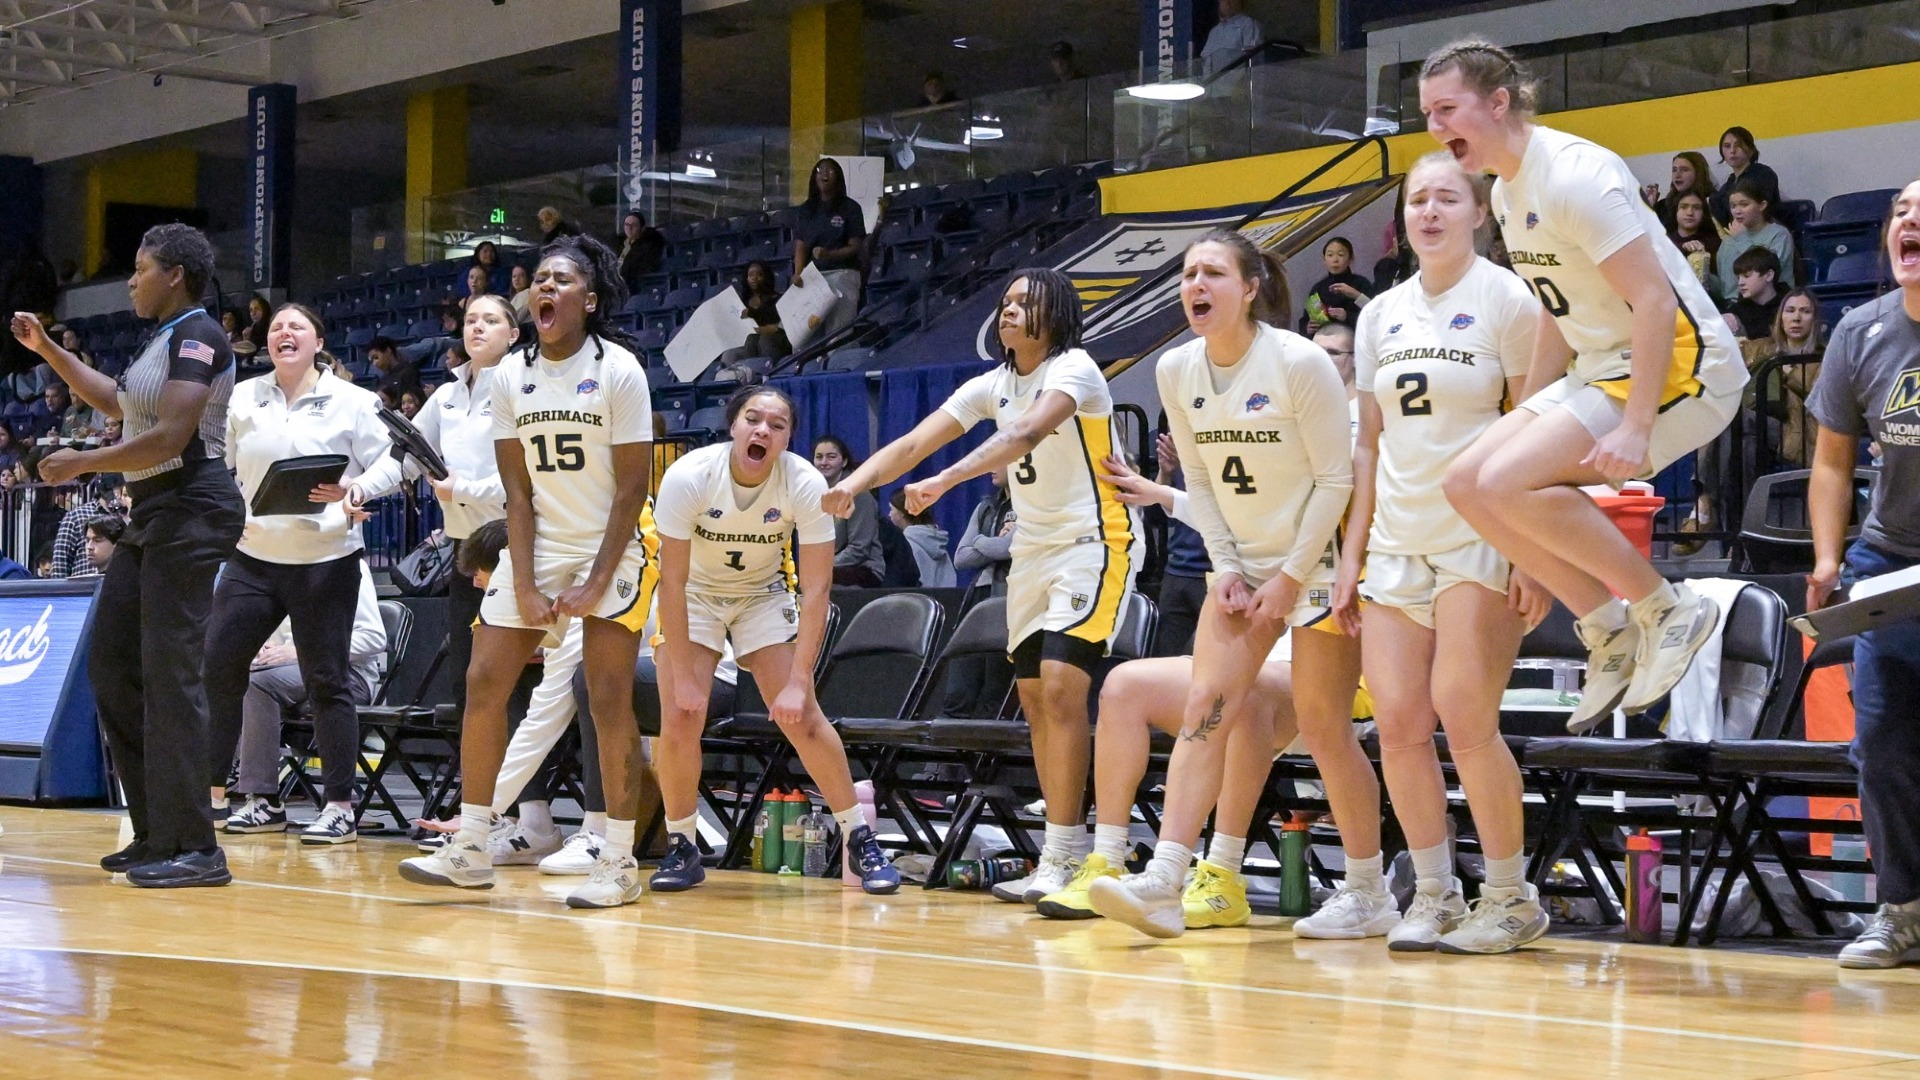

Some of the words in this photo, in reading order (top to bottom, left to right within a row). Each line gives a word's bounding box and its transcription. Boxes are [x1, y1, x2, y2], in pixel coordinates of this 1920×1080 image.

[632, 7, 644, 71] CLUB
[256, 95, 266, 150] CLUB
[254, 155, 265, 283] CHAMPIONS
[1378, 347, 1475, 367] MERRIMACK
[1396, 372, 1432, 416] 2
[515, 410, 603, 428] MERRIMACK
[530, 433, 585, 472] 15
[1015, 451, 1037, 485] 3
[1222, 455, 1257, 495] 4
[694, 524, 784, 544] MERRIMACK
[724, 550, 746, 572] 1
